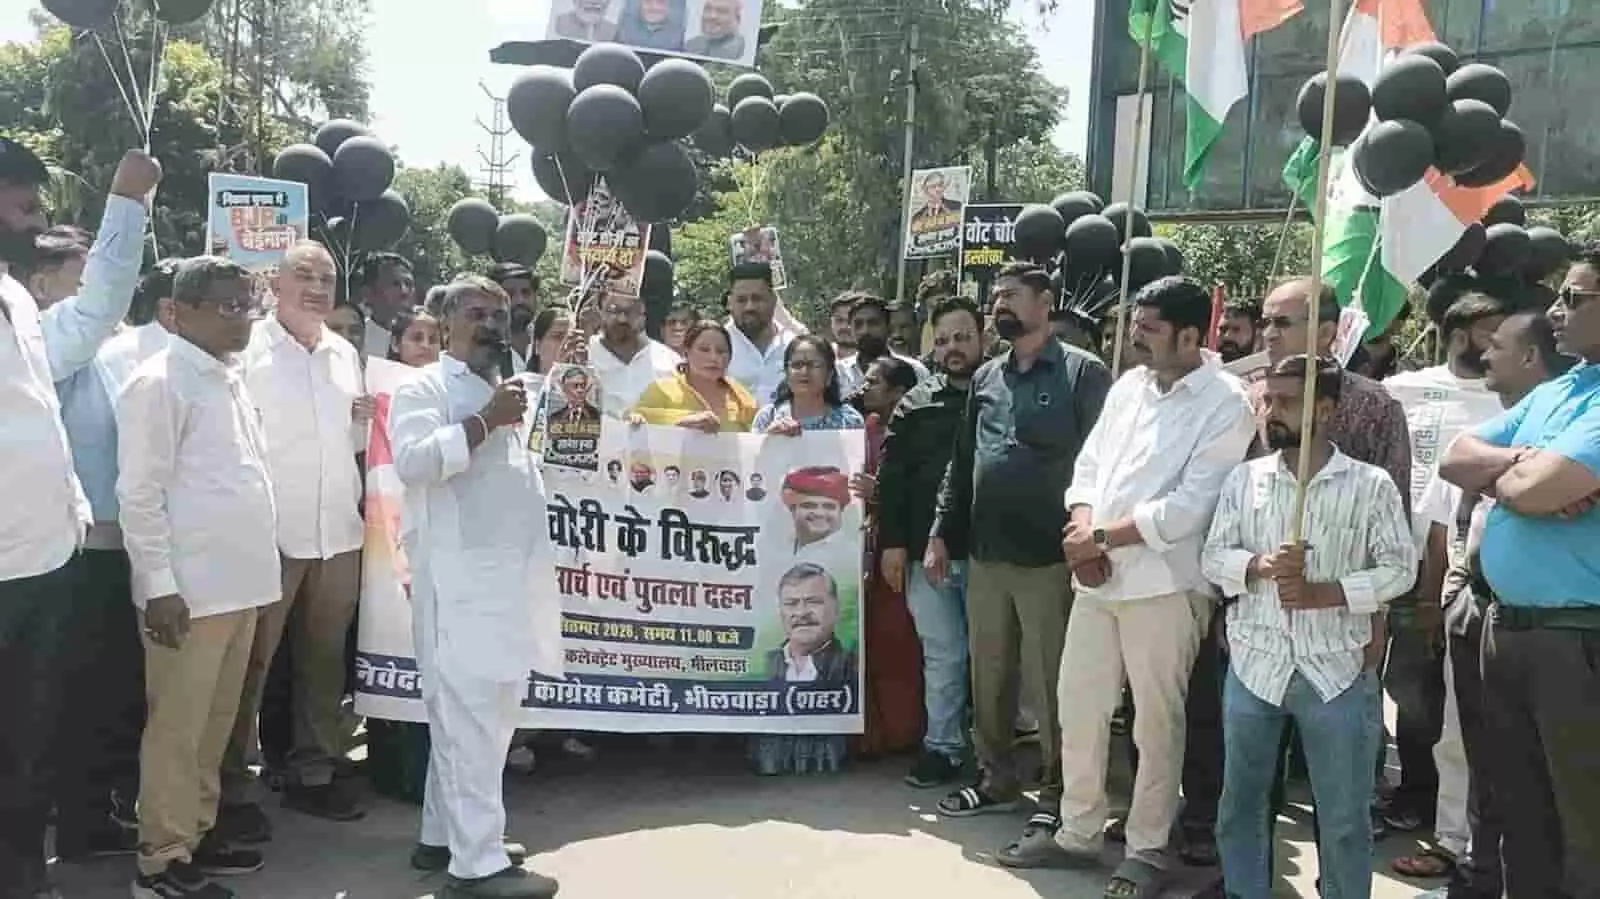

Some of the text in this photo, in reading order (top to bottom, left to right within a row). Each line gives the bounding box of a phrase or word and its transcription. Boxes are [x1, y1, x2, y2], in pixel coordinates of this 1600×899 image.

[965, 216, 992, 243] वोट
[547, 494, 760, 571] चोरी के विरुद्ध
[594, 568, 630, 600] एवं
[632, 577, 698, 613] पुतला
[703, 583, 753, 610] दहन
[644, 626, 676, 642] समय
[716, 628, 740, 645] बजे
[606, 681, 680, 712] कमेटी,
[684, 685, 780, 715] भीलवाड़ा
[786, 685, 853, 714] (शहर)
